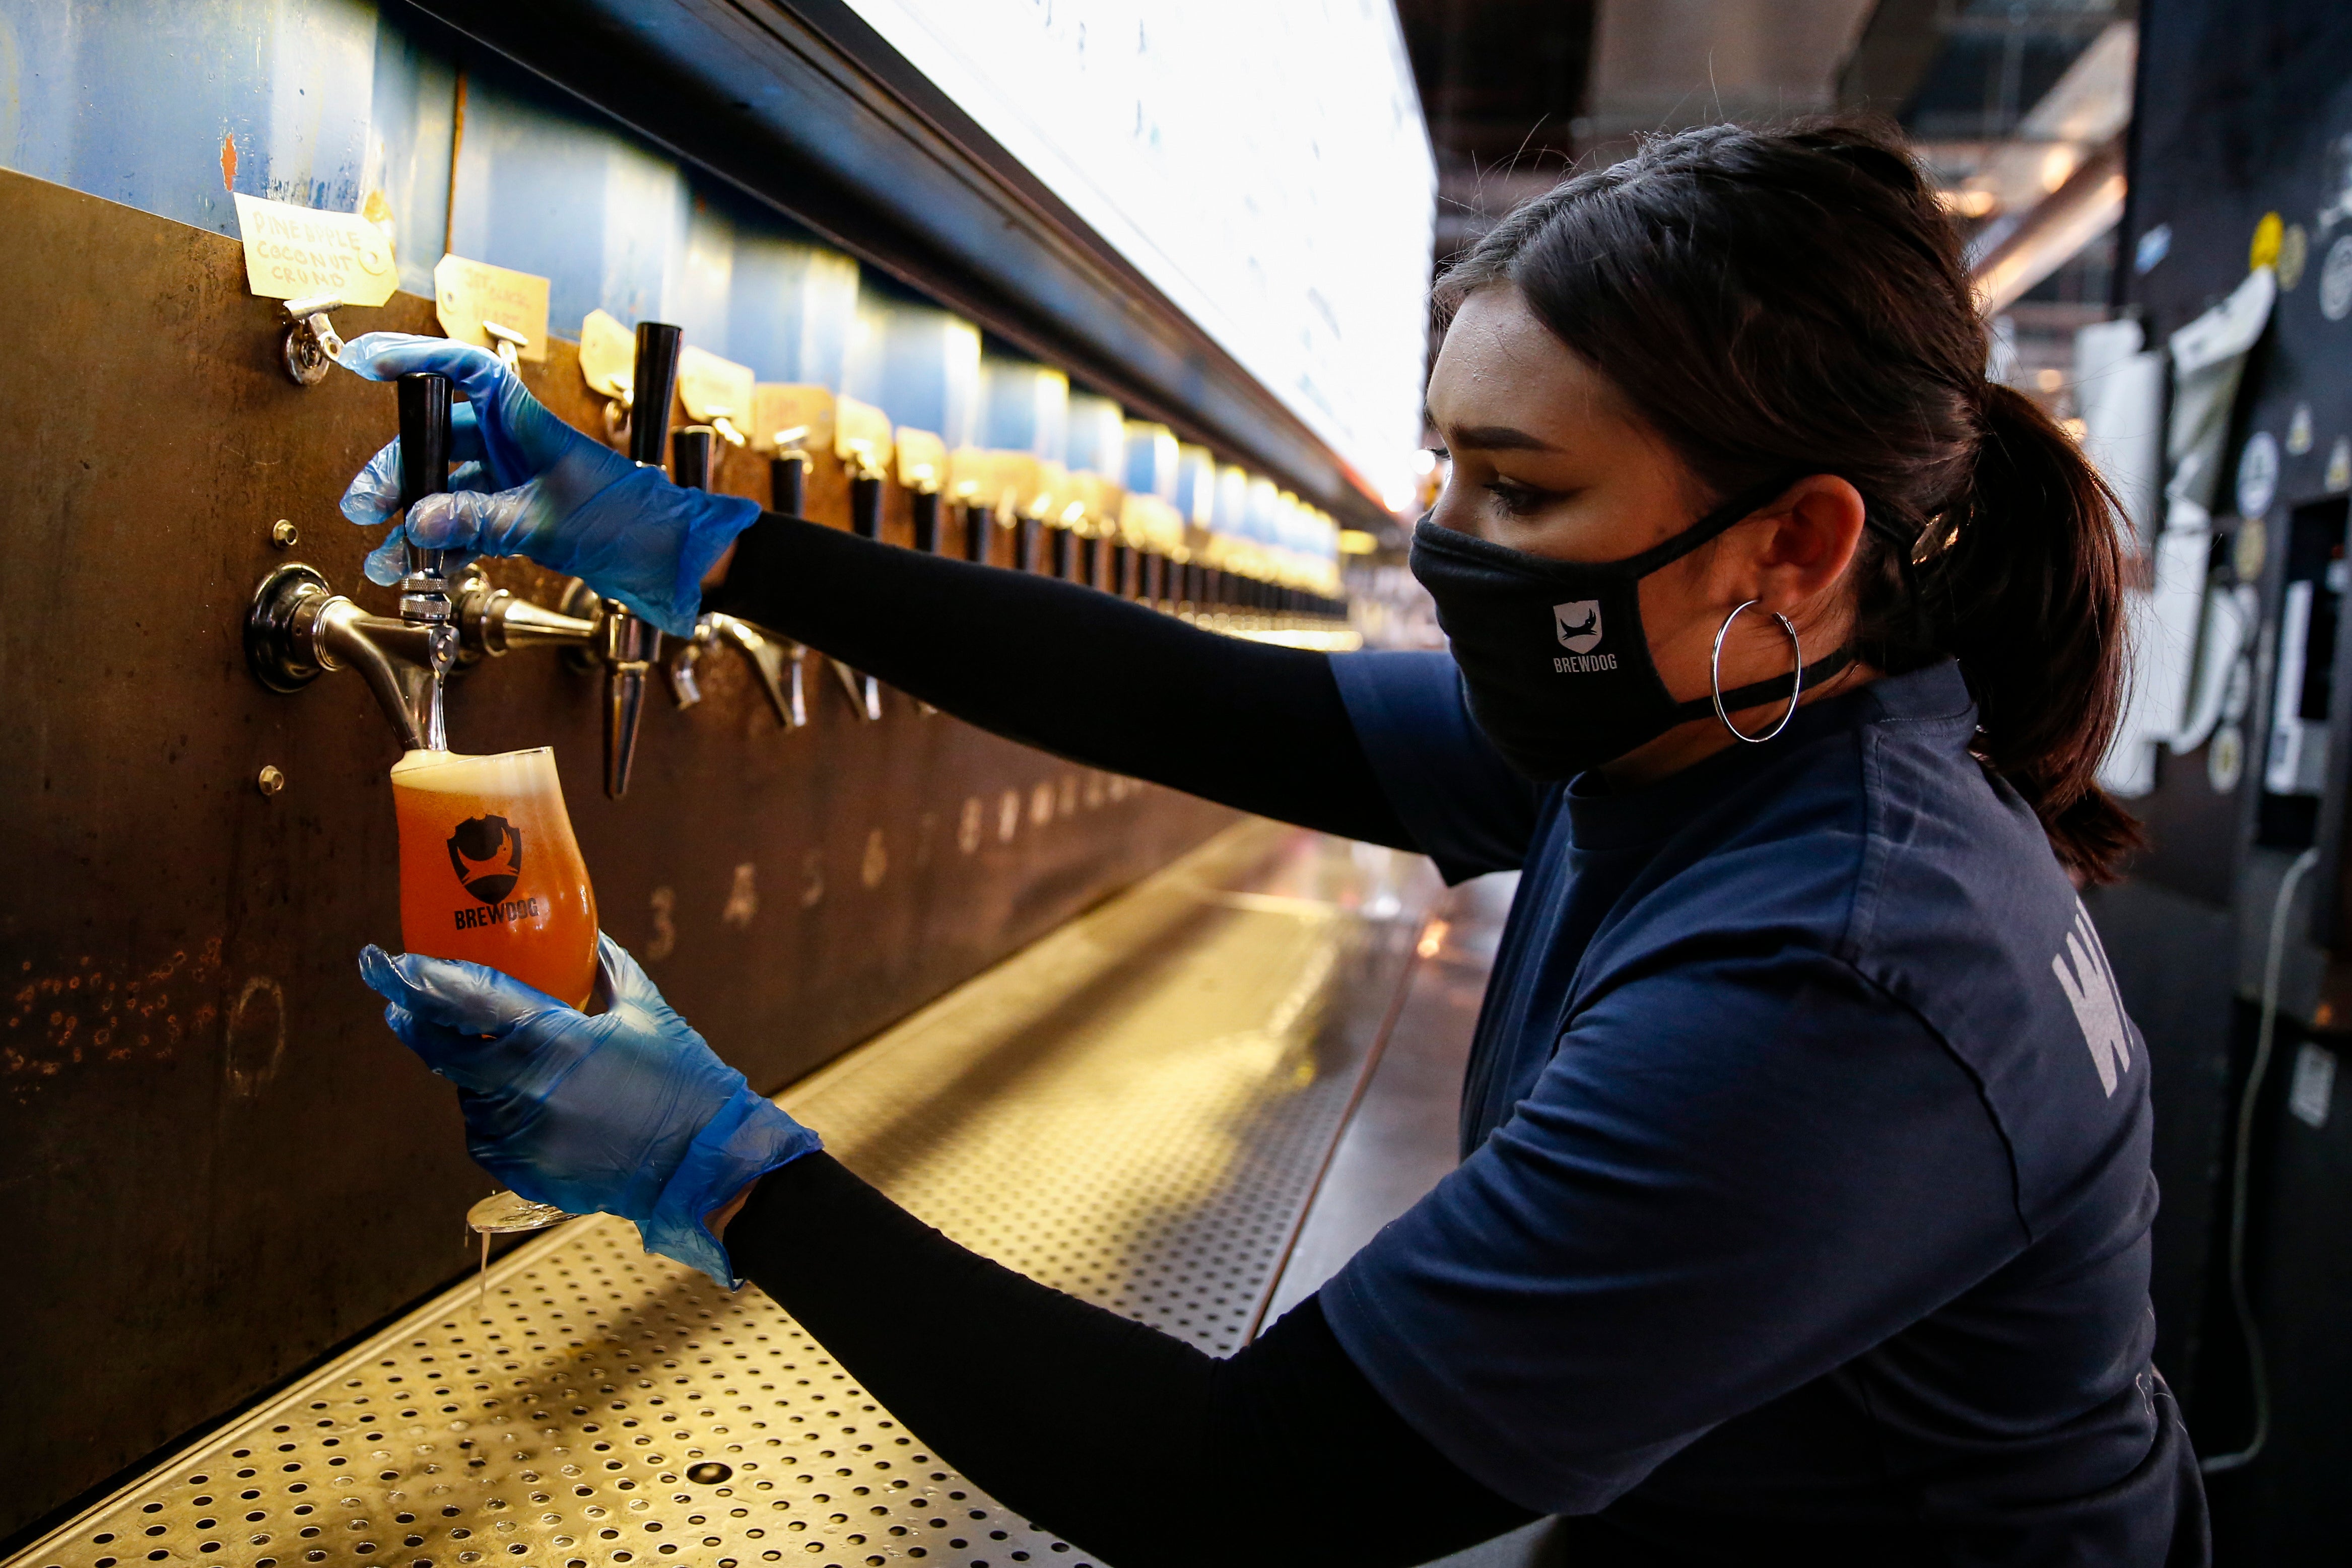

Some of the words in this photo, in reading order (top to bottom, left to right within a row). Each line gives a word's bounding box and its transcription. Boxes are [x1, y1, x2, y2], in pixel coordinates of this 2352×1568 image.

[252, 210, 361, 251] PINEAPPLE
[256, 240, 353, 271] COCONUT
[1553, 654, 1618, 673] BREWDOG
[454, 898, 539, 930] BREWDOG
